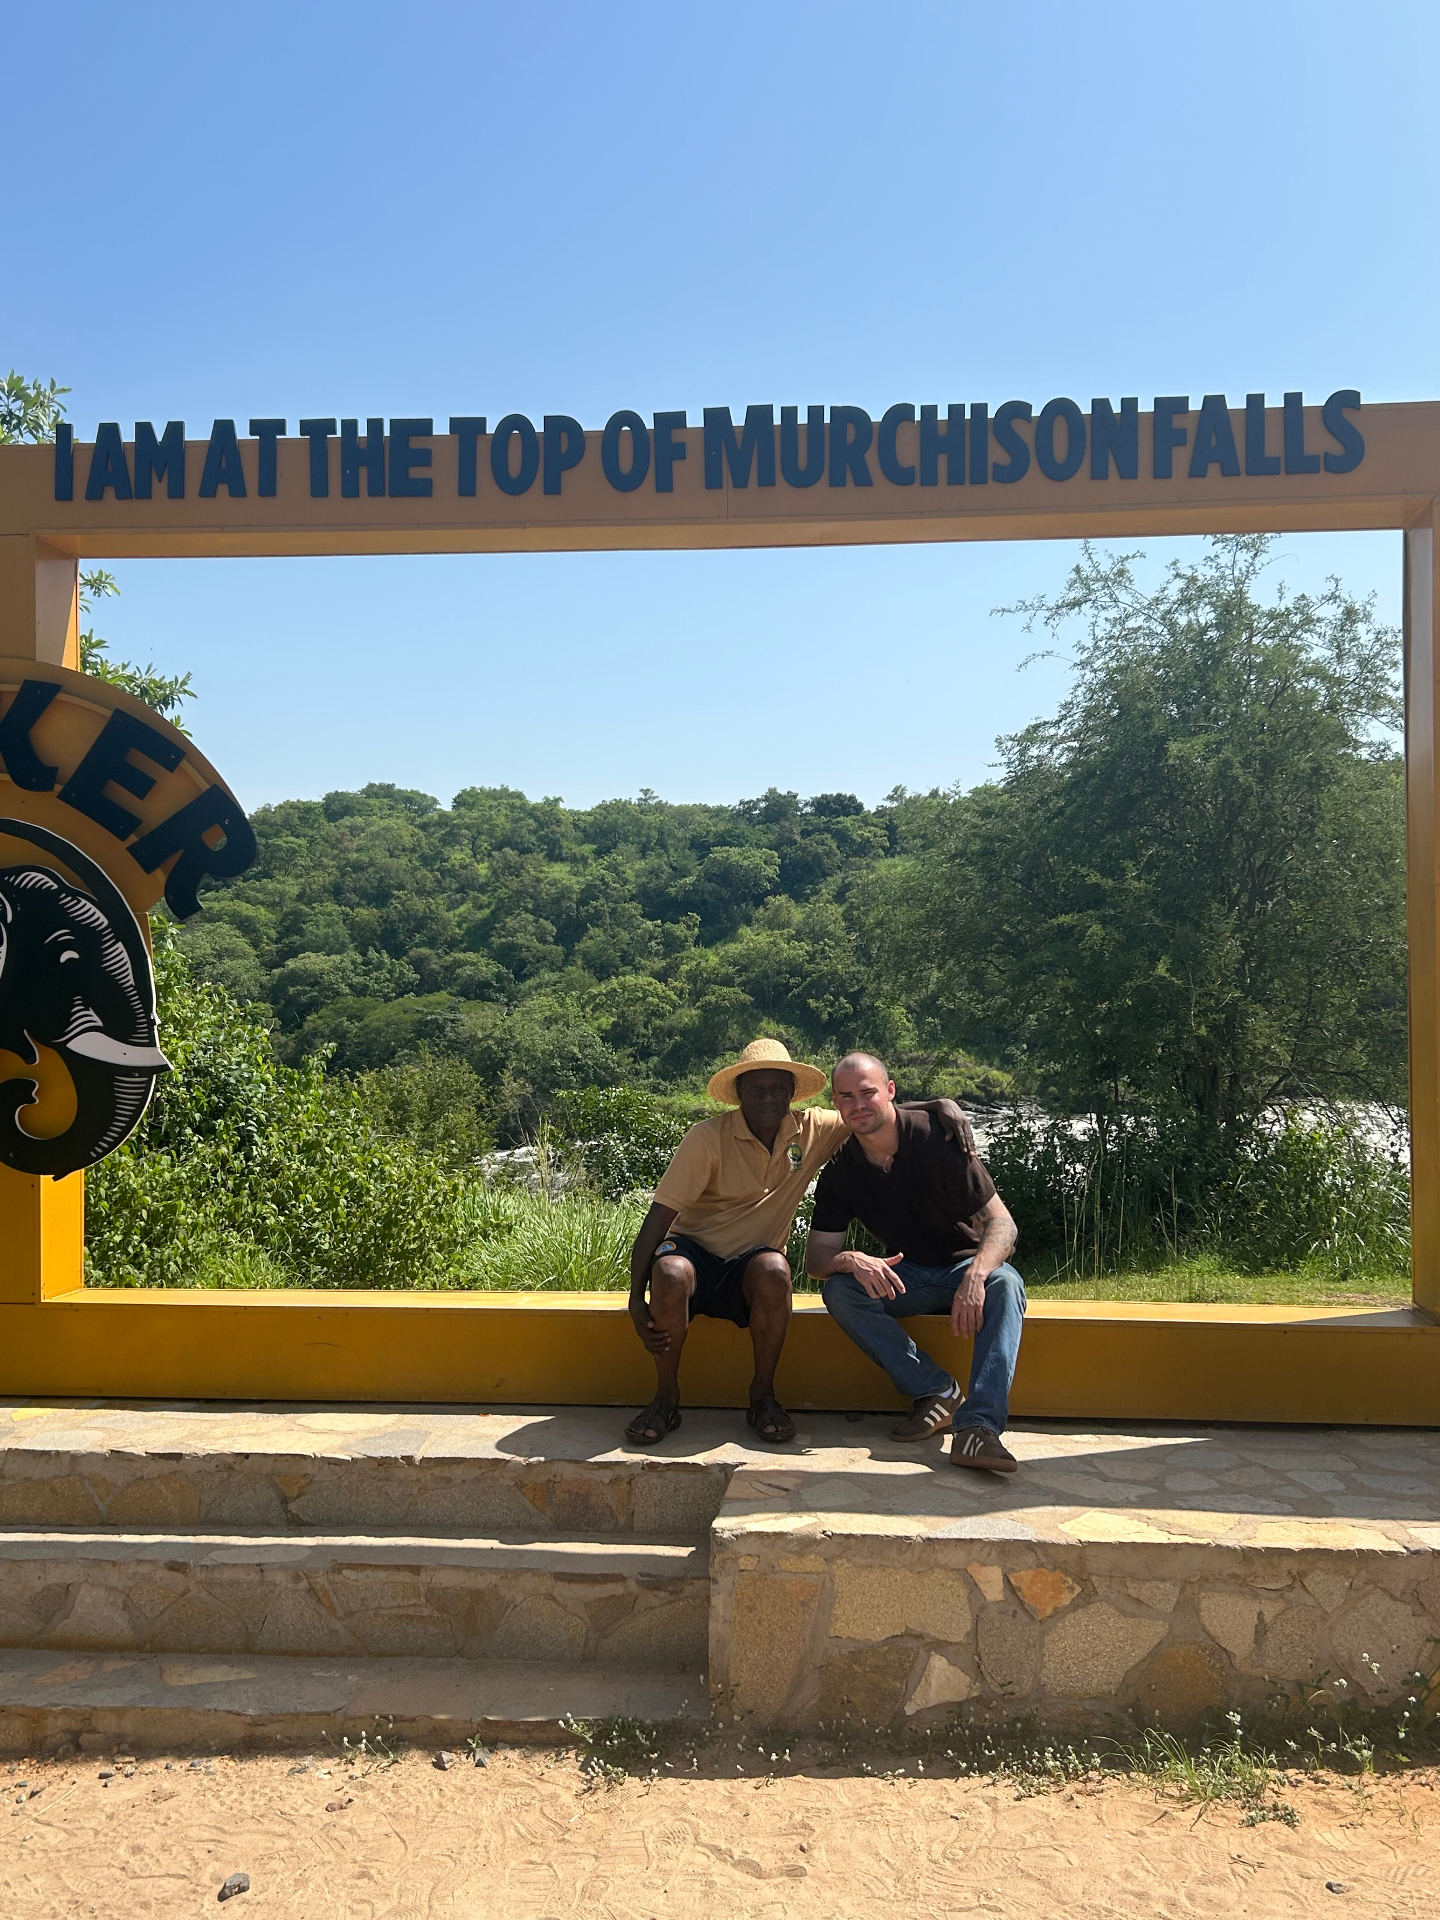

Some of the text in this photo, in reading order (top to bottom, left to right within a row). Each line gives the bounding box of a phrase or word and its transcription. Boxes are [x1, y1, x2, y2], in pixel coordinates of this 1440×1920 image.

[55, 389, 1366, 501] I AM AT THE TOP OF MURCHISON FALLS
